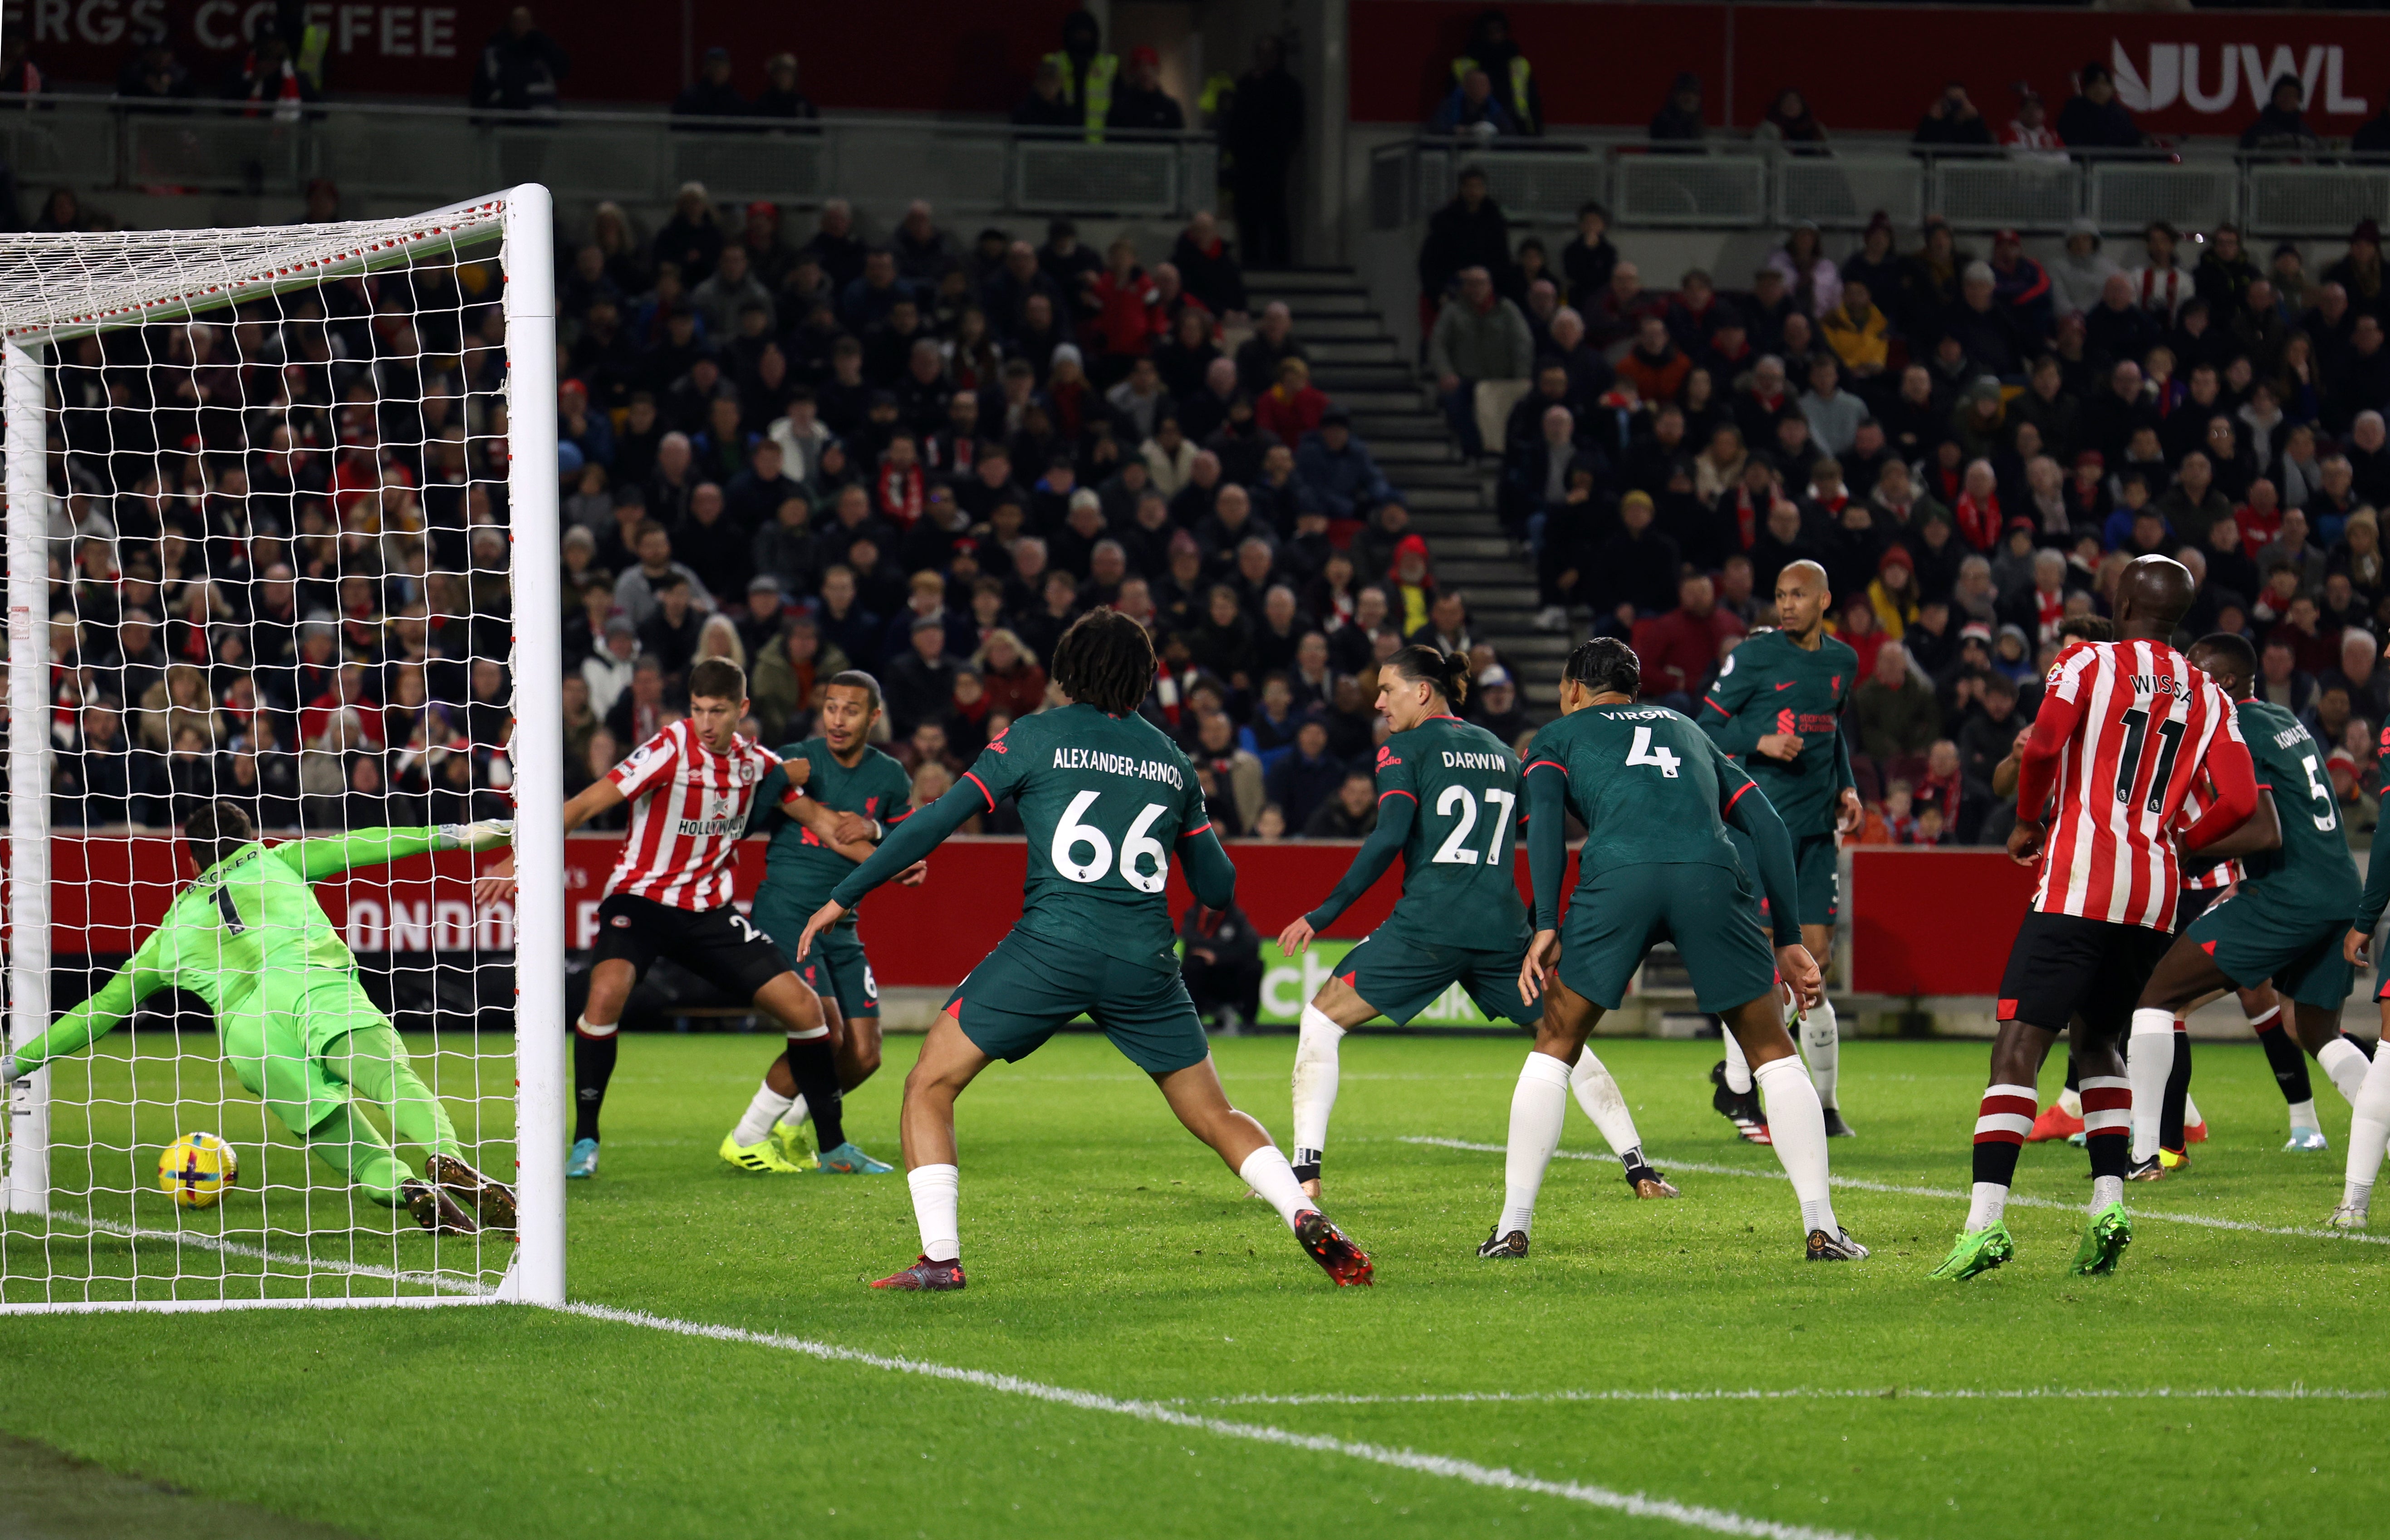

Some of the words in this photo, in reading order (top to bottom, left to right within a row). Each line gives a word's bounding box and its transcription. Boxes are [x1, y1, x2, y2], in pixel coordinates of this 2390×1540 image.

[1599, 711, 1678, 721] VIRGIL
[2129, 675, 2193, 711] WISSA
[1053, 748, 1183, 791] ALEXANDER-ARNOLD
[1442, 751, 1506, 772] DARWIN
[1625, 726, 1681, 778] 4
[2116, 707, 2188, 815] 11
[2302, 754, 2336, 831] 5
[1051, 790, 1168, 893] 66
[1432, 785, 1516, 865] 27
[186, 850, 258, 895] BECKER
[209, 884, 247, 937] 1
[864, 965, 878, 999] 6
